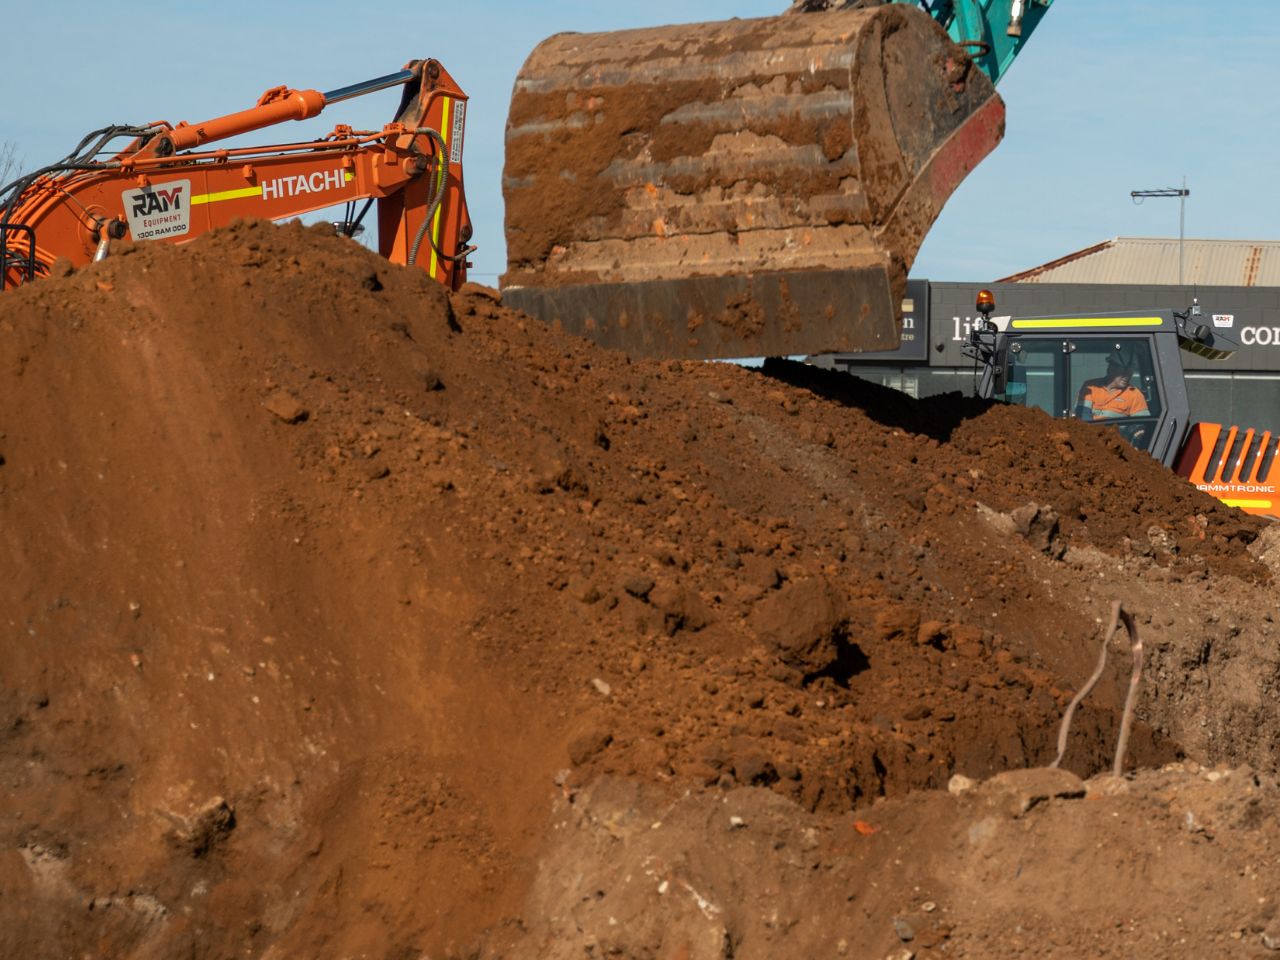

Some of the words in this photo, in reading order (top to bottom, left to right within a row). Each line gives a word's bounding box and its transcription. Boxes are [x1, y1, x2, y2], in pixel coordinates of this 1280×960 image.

[261, 168, 346, 201] HITACHI
[131, 186, 183, 218] RAM
[137, 230, 154, 239] 1300
[155, 226, 171, 236] RAM
[143, 214, 182, 228] EQUIPMENT
